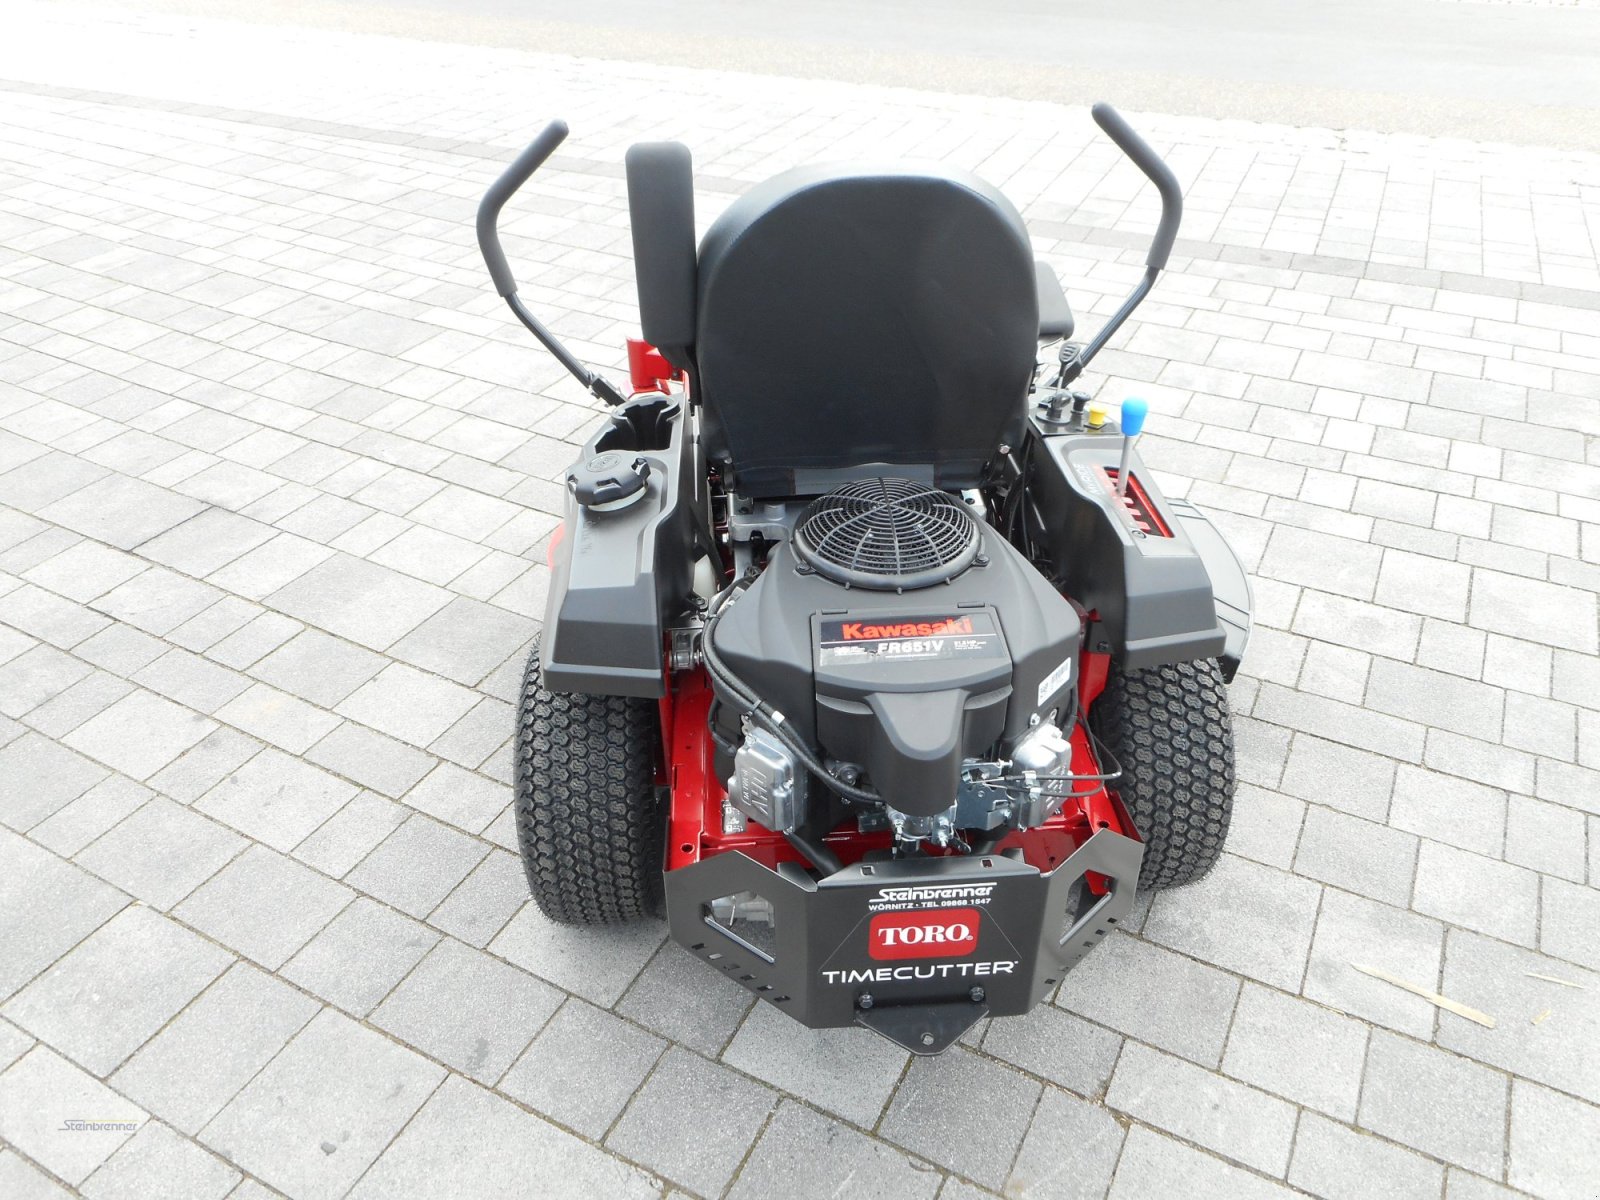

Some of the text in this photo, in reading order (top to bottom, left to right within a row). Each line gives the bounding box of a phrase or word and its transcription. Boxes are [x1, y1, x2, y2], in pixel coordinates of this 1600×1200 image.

[842, 618, 973, 640] Kawasaki
[877, 640, 944, 654] FR651V
[869, 882, 997, 903] Steinbrenner
[869, 902, 914, 911] WÖRNITZ
[970, 897, 992, 905] 1547
[878, 924, 969, 946] TORO
[823, 961, 1018, 984] TIMECUTTER
